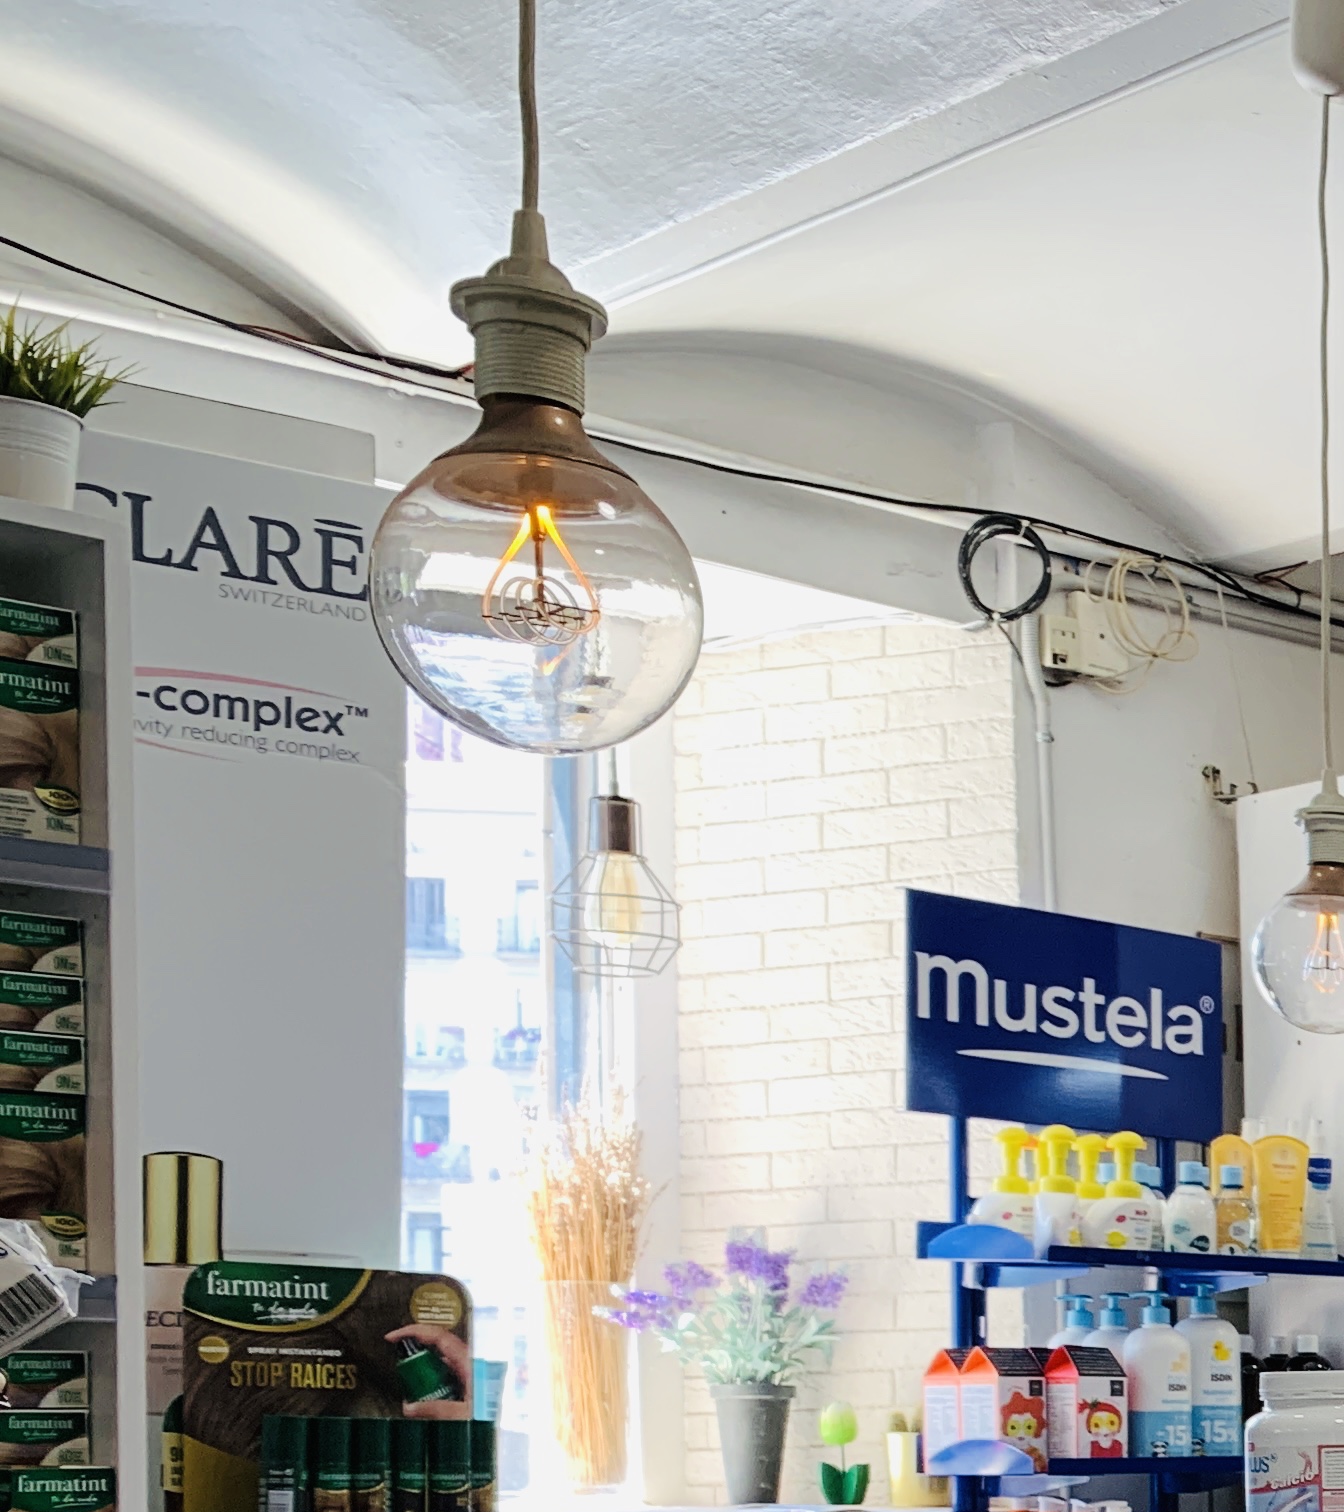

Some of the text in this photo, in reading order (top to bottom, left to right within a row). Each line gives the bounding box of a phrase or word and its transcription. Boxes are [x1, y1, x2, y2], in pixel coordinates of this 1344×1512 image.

[218, 583, 367, 623] SWITZERLAND
[181, 725, 268, 754] reducing
[275, 737, 361, 763] complex
[206, 1270, 330, 1301] farmatint
[230, 1361, 357, 1390] STOP RAÍCES
[17, 1475, 109, 1496] farmatint
